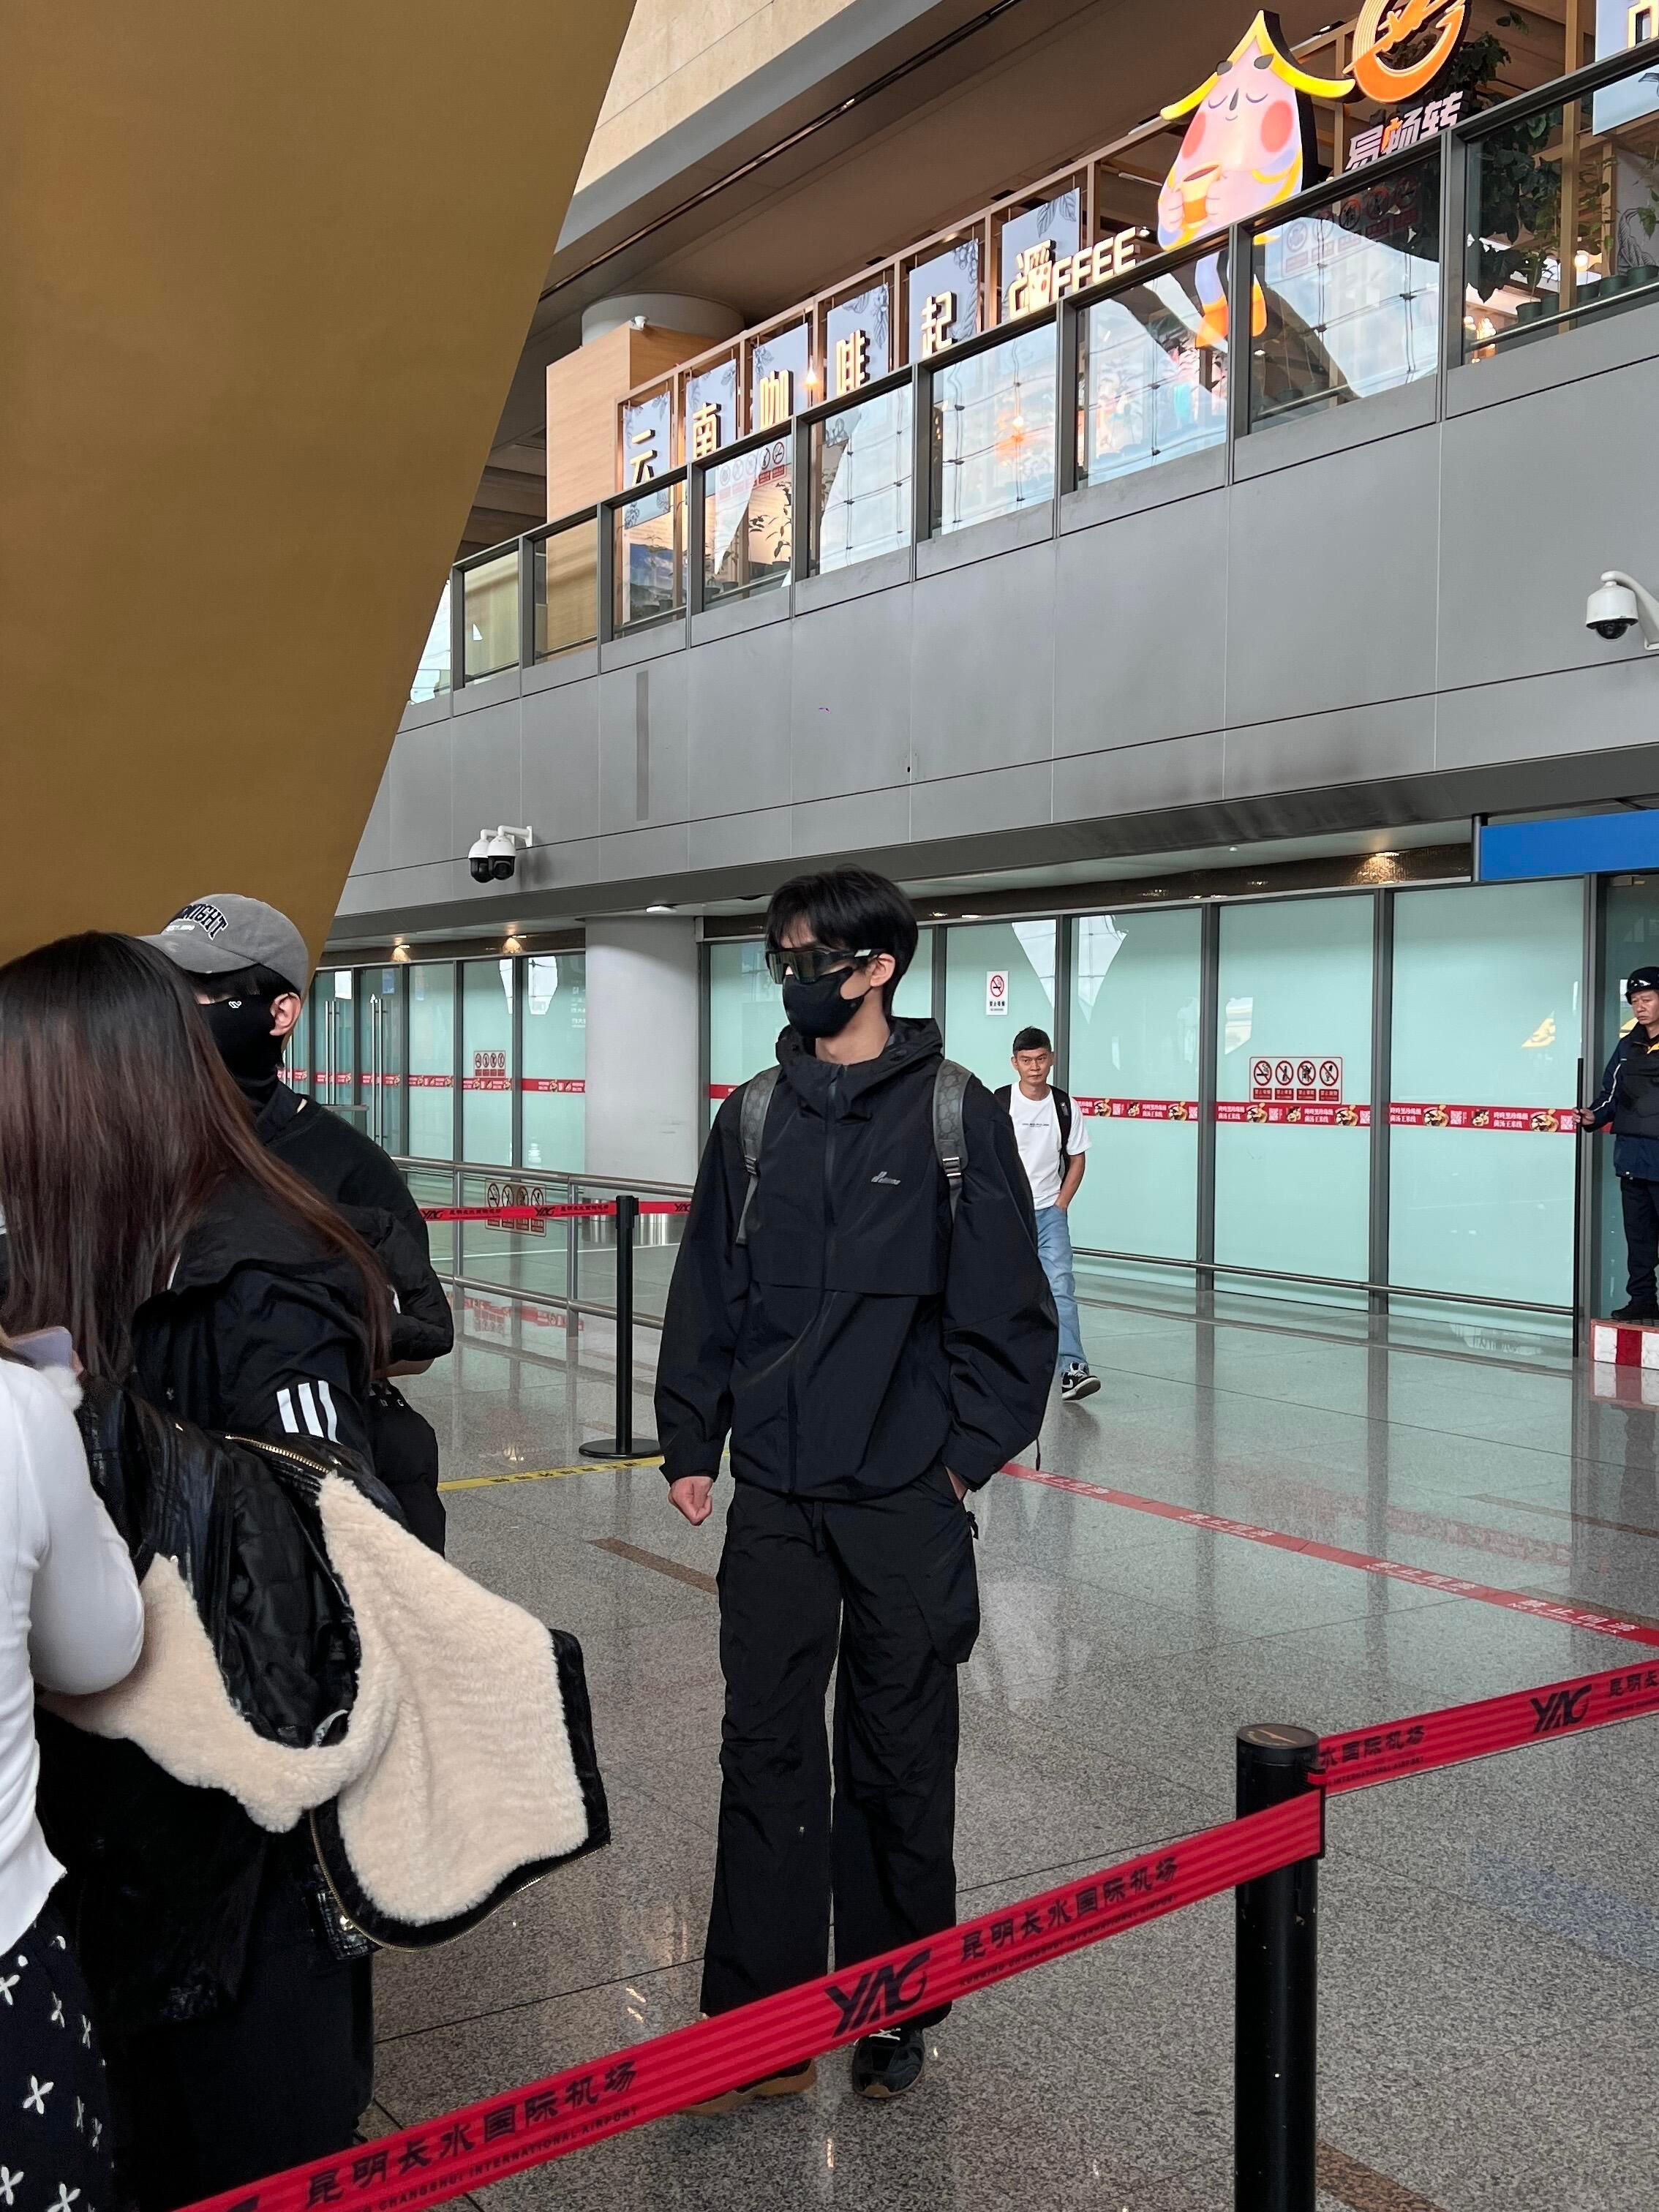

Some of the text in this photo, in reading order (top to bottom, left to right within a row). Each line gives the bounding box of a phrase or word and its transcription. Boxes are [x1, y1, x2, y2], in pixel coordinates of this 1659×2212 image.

[1009, 226, 1136, 320] CFFEE
[960, 1856, 1178, 1963] 昆明长水国际机场
[305, 2060, 637, 2211] 昆明长水国际机场
[469, 2128, 577, 2178] INTERNATIONAL
[582, 2105, 639, 2134] AIRPORT
